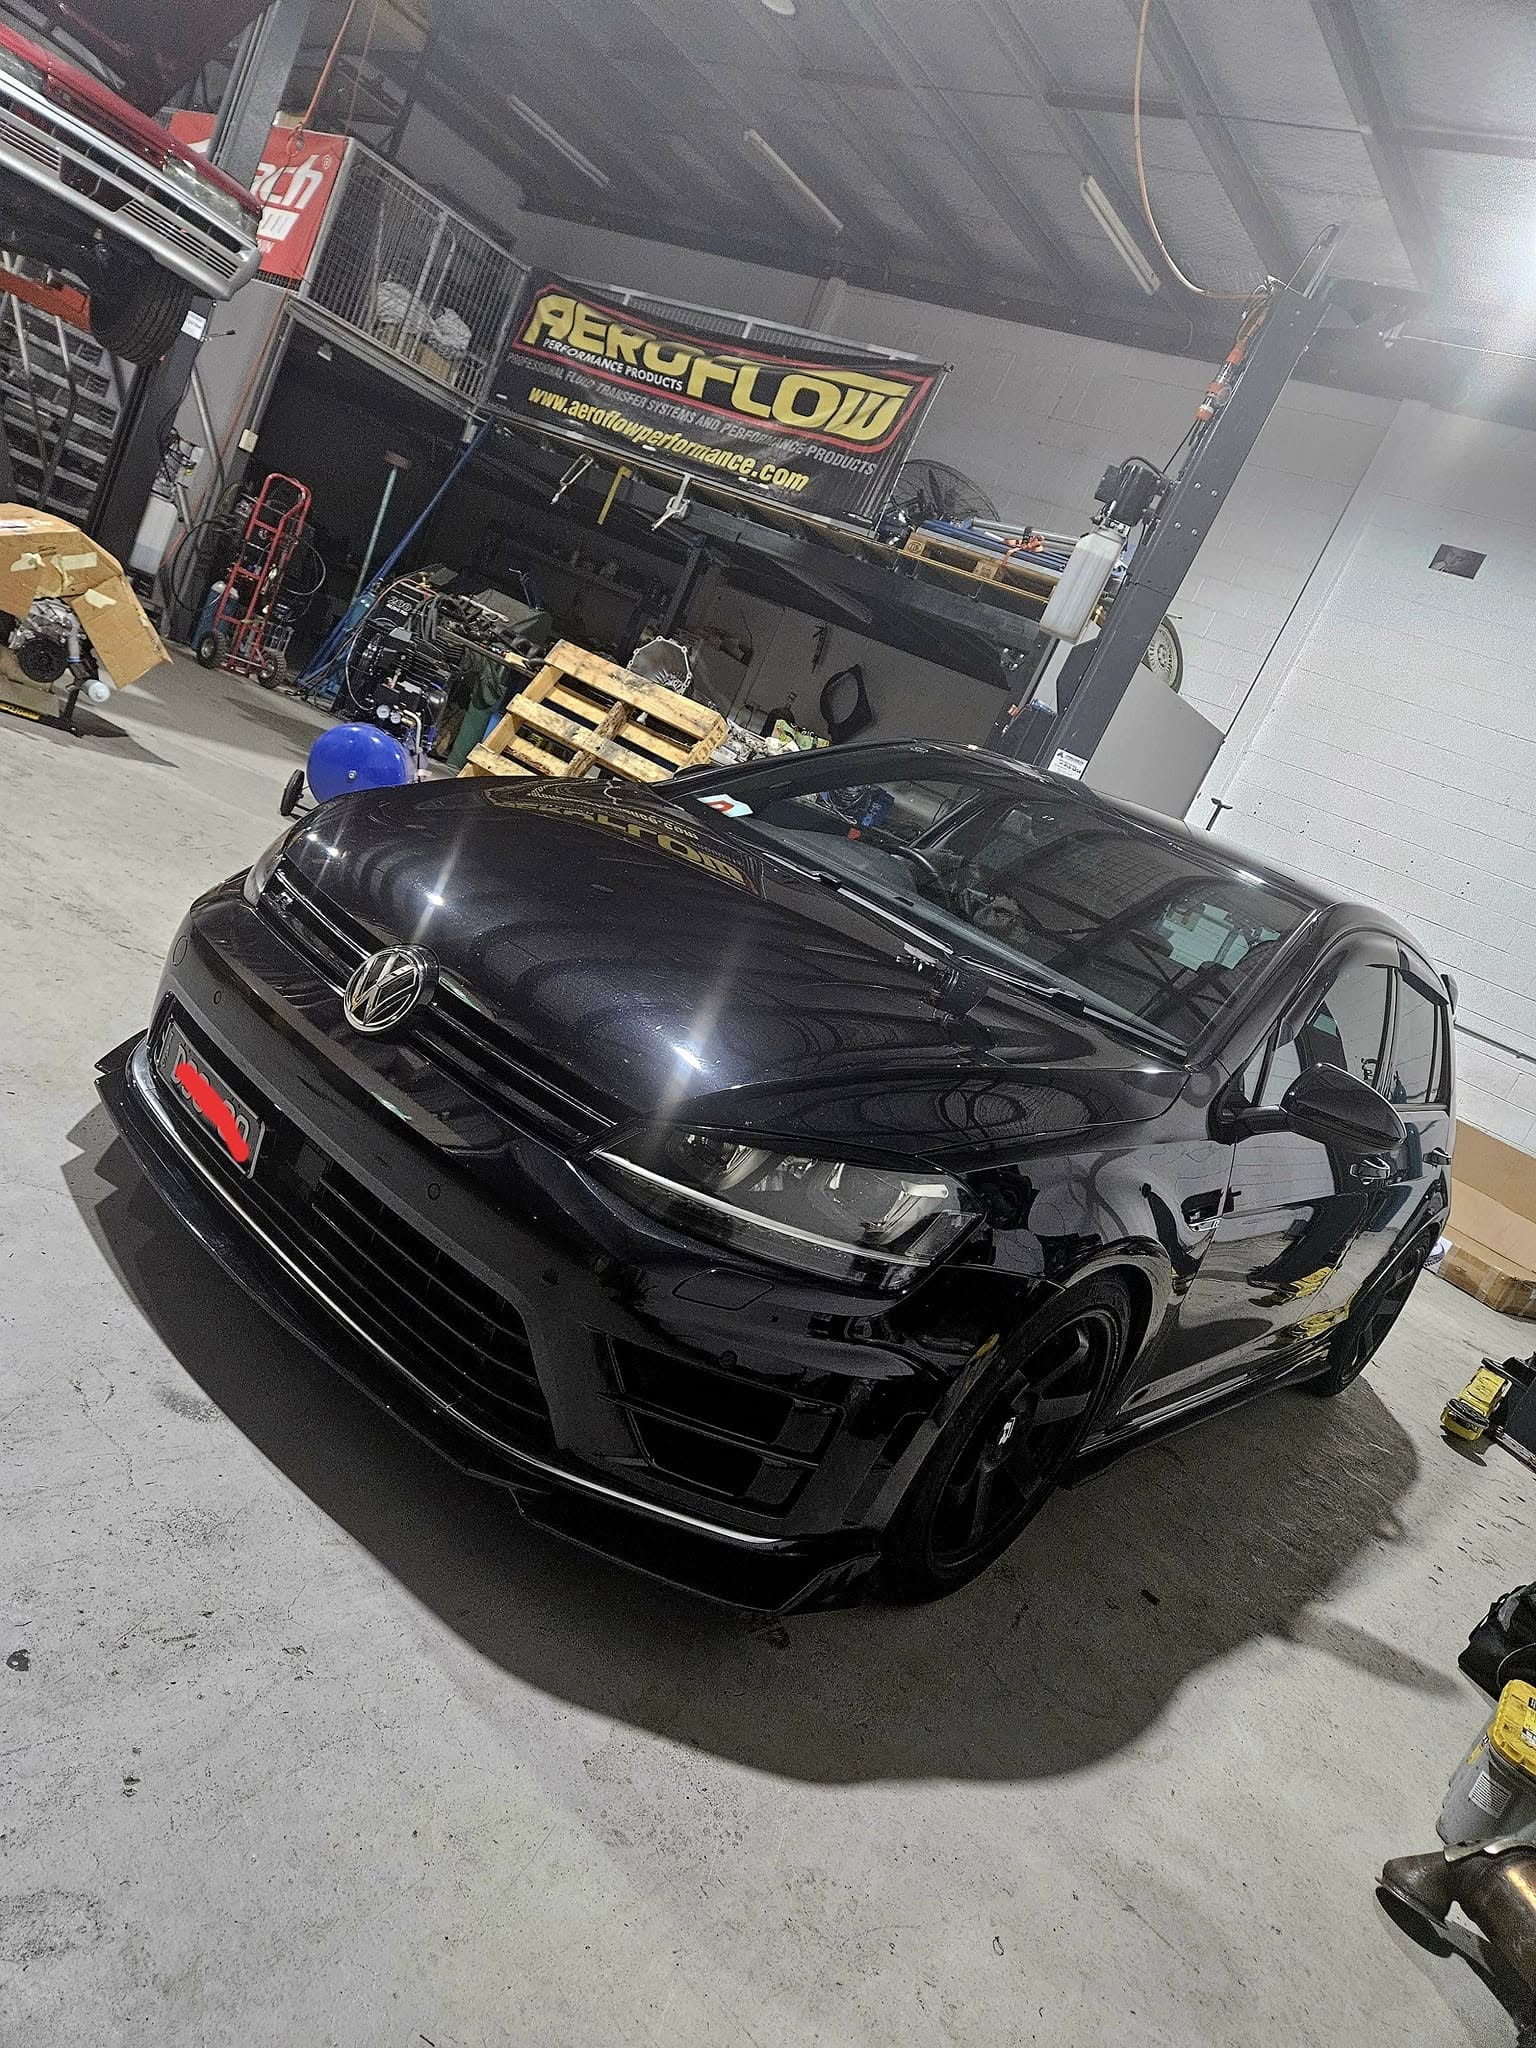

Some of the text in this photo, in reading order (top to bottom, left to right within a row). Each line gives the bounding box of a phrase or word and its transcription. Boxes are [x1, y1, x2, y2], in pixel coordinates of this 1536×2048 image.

[522, 294, 911, 441] AEROFLOW
[543, 337, 684, 392] PERFORMANCE PRODUCTS
[527, 387, 810, 492] www.aeroflowperformance.com
[563, 371, 596, 391] FLUID
[595, 382, 648, 407] TRANSFER
[646, 399, 695, 425] SYSTEMS
[694, 414, 720, 432] AND
[720, 423, 807, 455] PERFORMANCE
[805, 445, 878, 476] PRODUCTS
